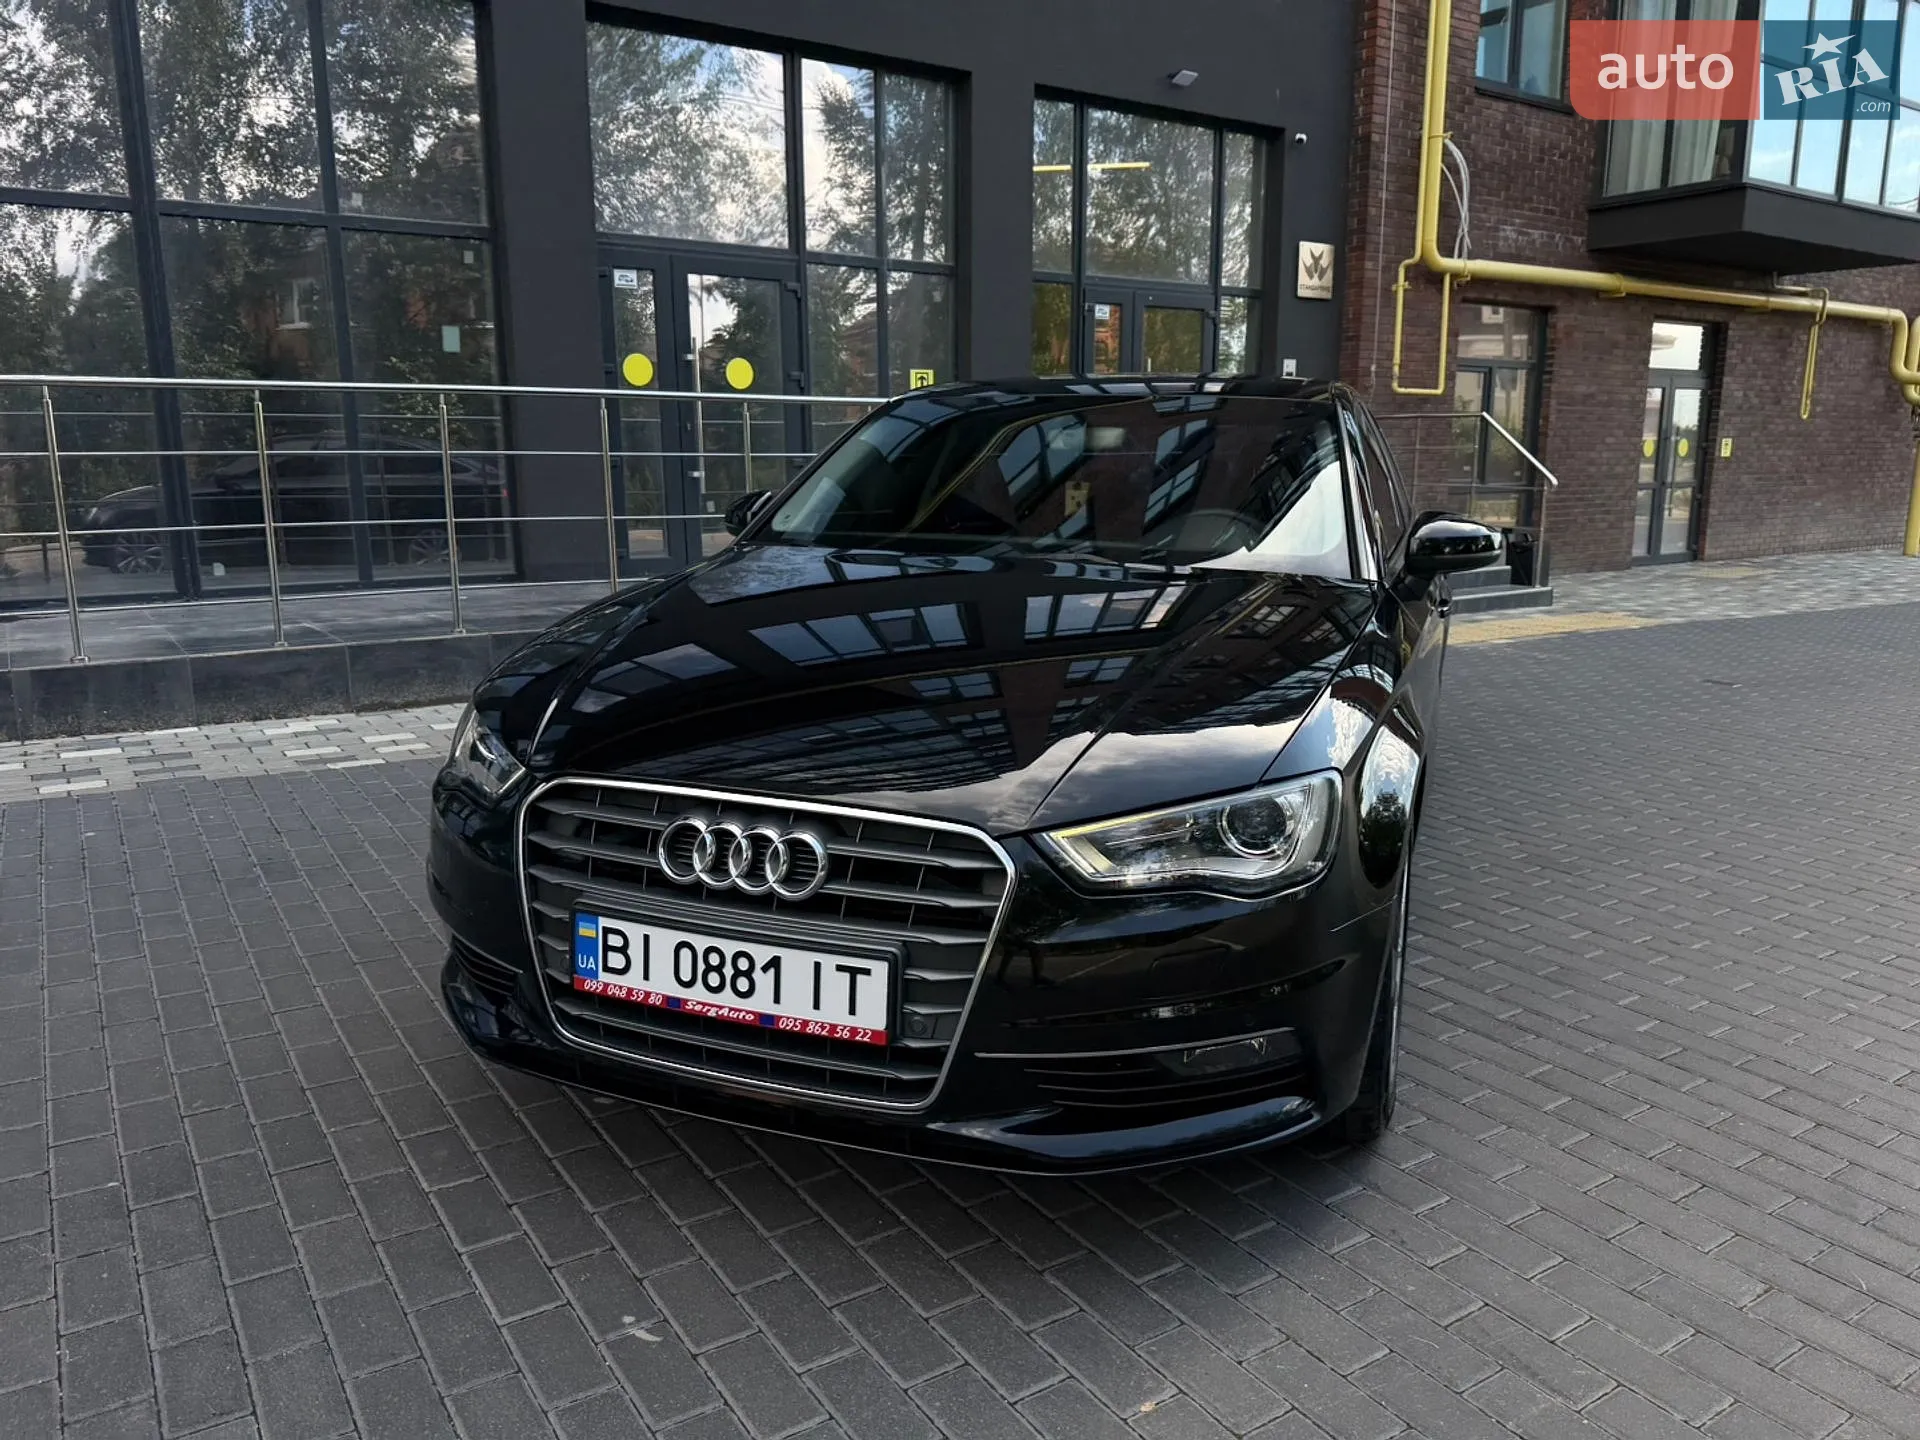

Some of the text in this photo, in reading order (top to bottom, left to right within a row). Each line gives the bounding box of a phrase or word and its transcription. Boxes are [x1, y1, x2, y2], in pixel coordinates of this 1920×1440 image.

[578, 953, 596, 971] UA
[602, 926, 872, 1017] BI 0881 IT
[583, 979, 872, 1042] 099 048 59 80 SergAuto 095 862 56 22
